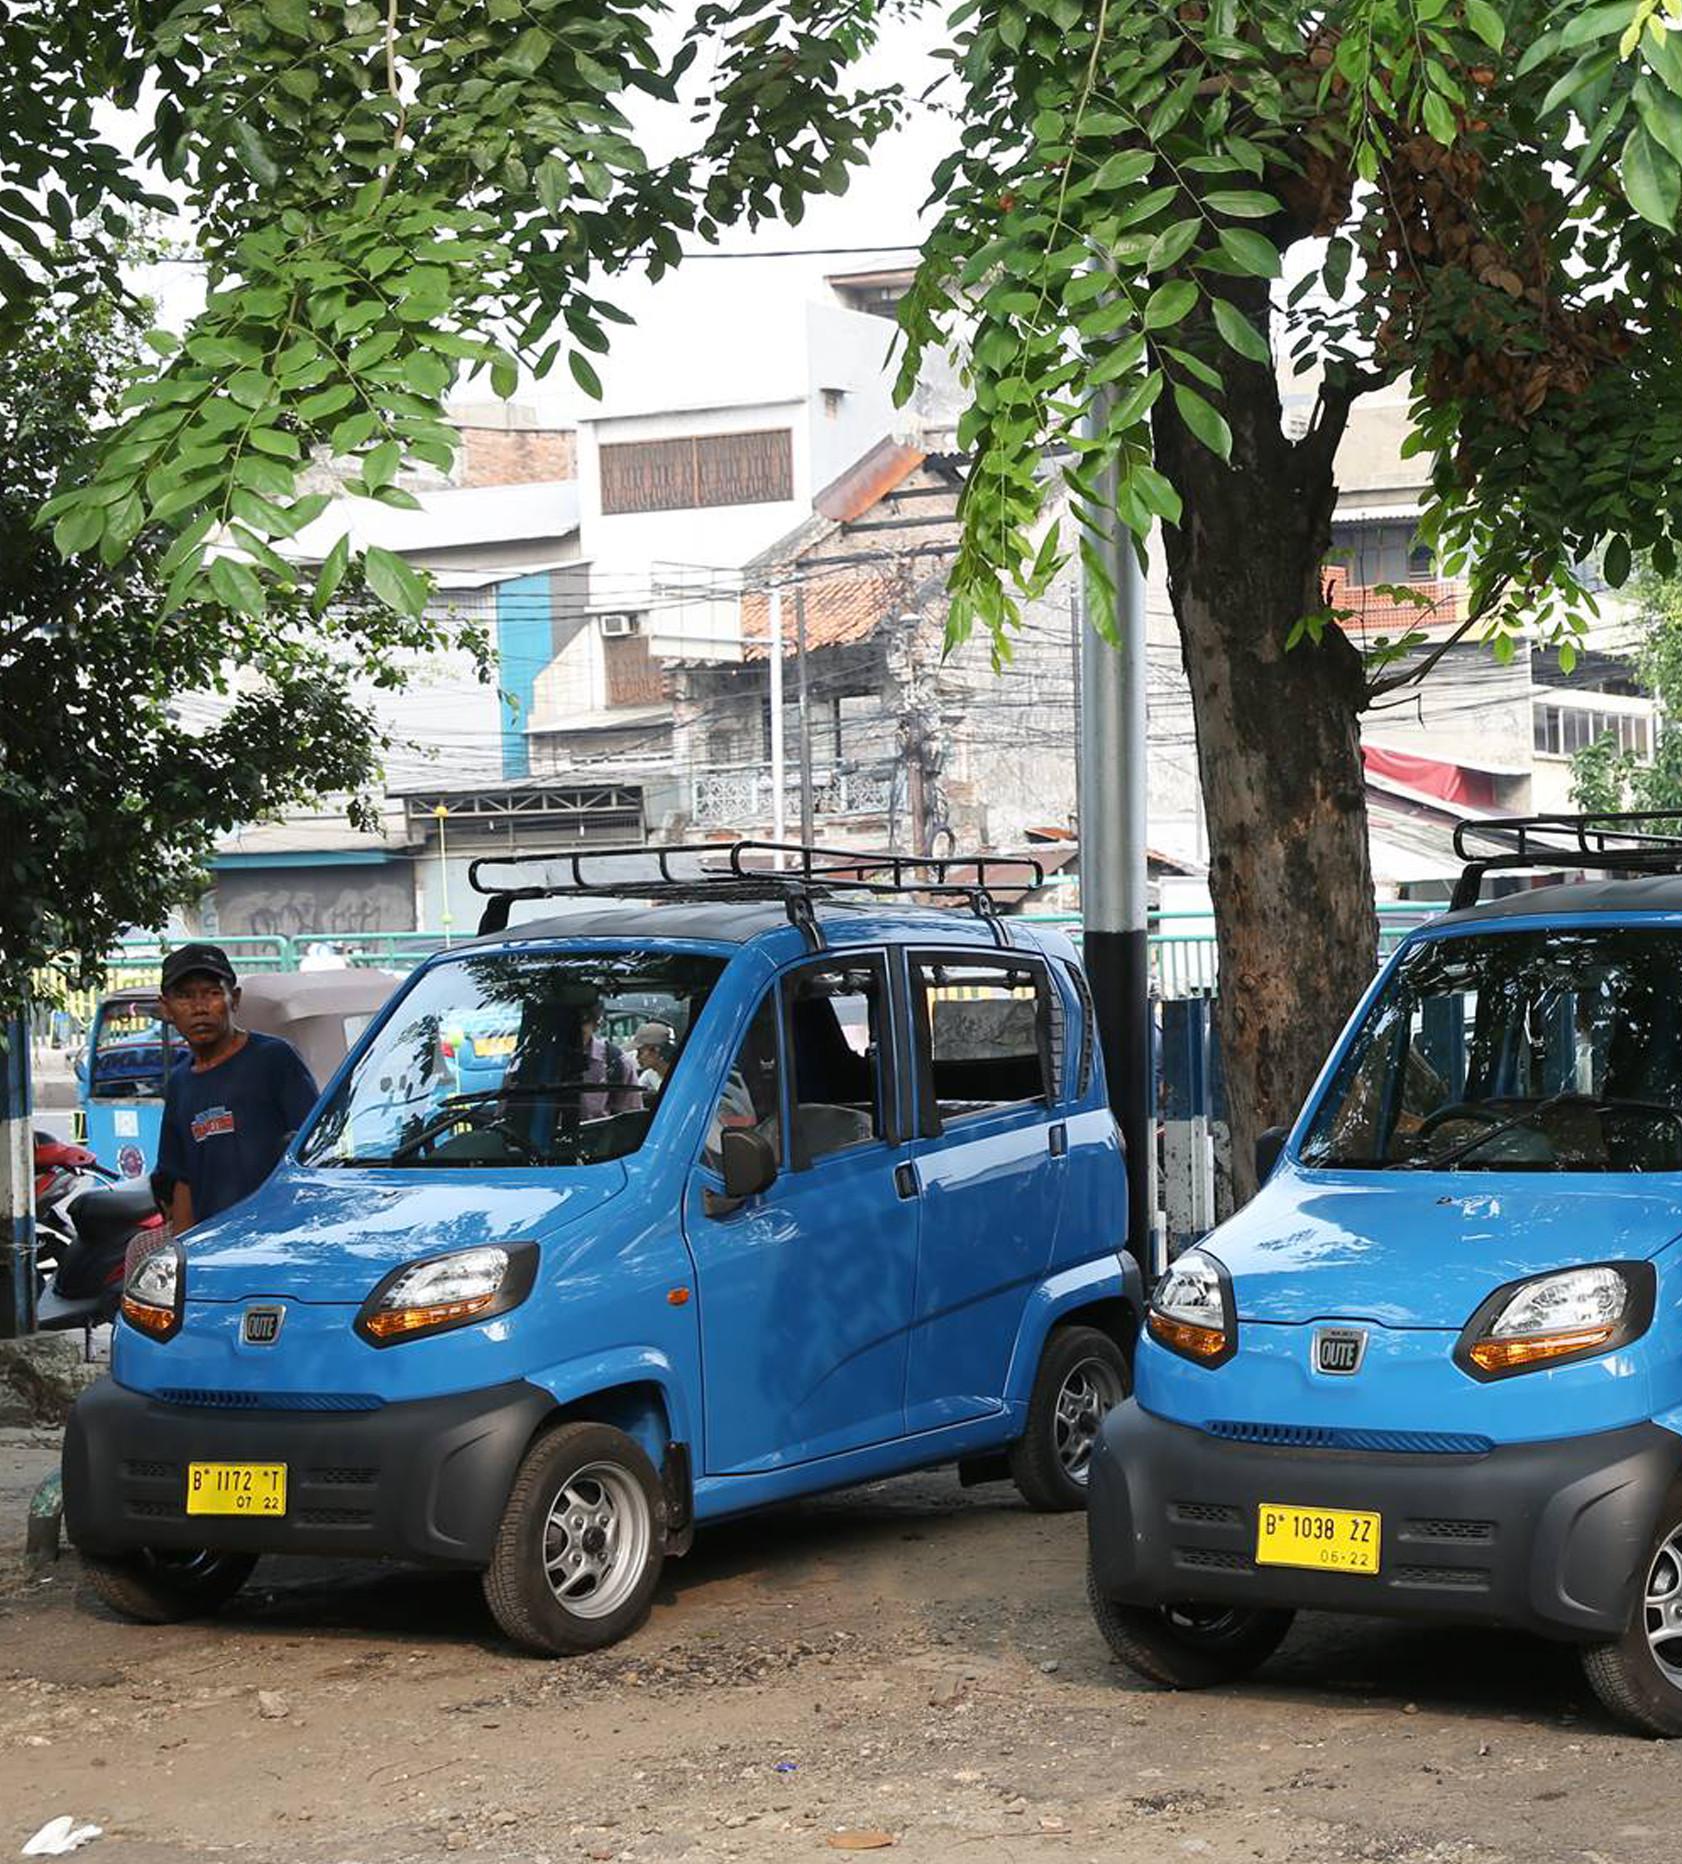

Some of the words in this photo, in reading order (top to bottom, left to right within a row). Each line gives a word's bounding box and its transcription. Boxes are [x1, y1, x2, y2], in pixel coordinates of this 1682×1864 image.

[193, 1470, 202, 1491] B
[217, 1470, 252, 1491] 1172
[1266, 1513, 1276, 1535] B
[1294, 1516, 1334, 1540] 1038
